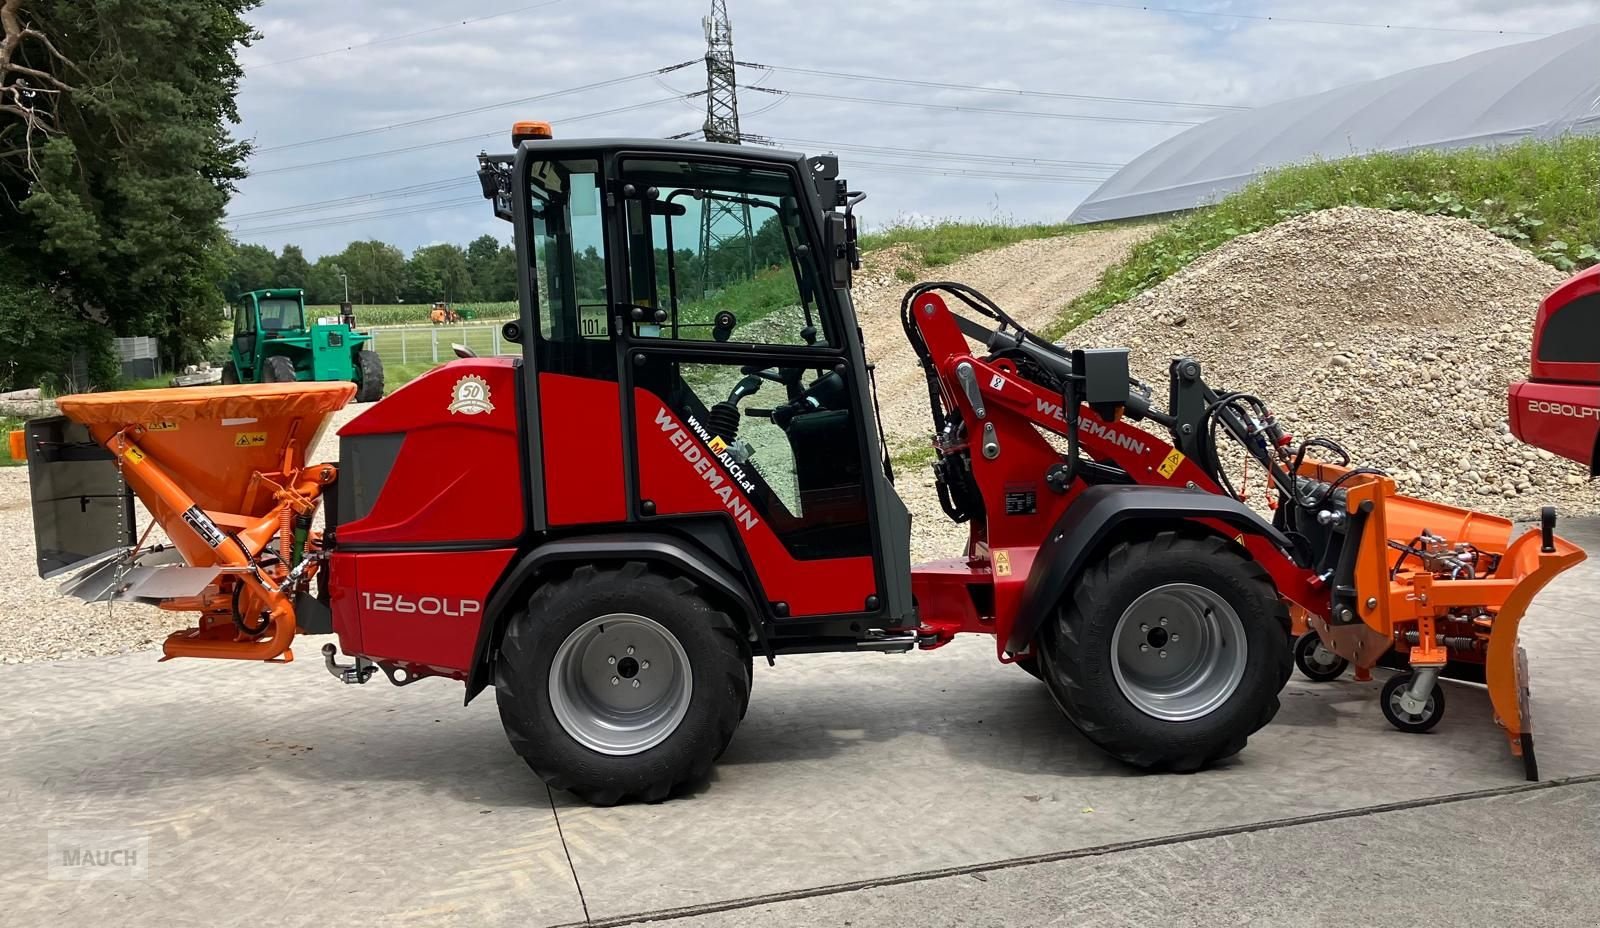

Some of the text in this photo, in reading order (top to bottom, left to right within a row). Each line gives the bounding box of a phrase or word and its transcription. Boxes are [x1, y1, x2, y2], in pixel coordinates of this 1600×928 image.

[582, 319, 599, 335] 101
[463, 385, 480, 398] 50
[1528, 400, 1600, 420] 2080LPT
[1036, 398, 1145, 455] WEEMANN
[687, 415, 755, 494] www.MAUCH.at
[654, 407, 759, 531] WEIDEMANN
[362, 592, 480, 617] 1260LP
